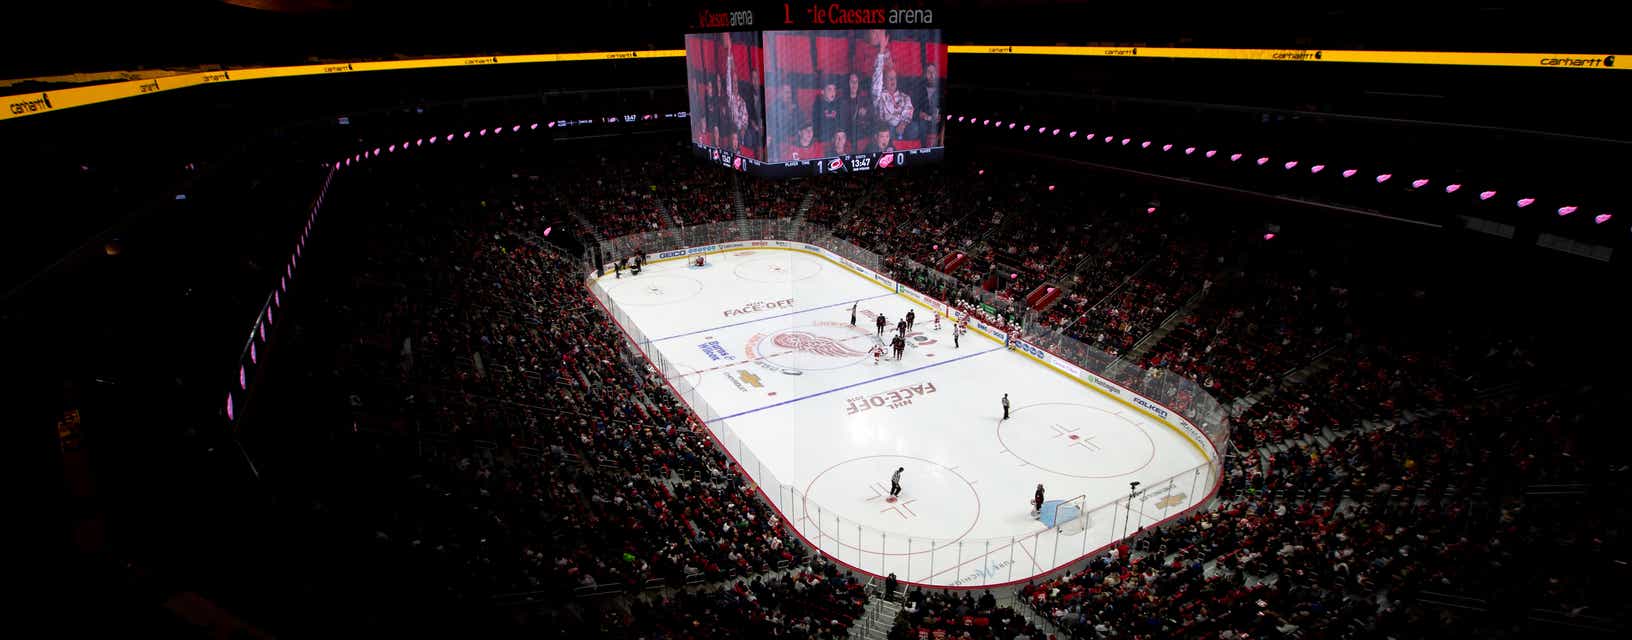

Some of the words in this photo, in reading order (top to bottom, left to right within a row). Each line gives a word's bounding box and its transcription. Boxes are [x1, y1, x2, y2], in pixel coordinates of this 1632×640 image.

[730, 9, 753, 26] arena
[828, 4, 885, 24] Caesars
[888, 8, 933, 24] arena
[1540, 58, 1602, 67] carhartt
[10, 98, 47, 115] carhartt
[818, 160, 823, 173] 1
[851, 158, 871, 169] 13:47
[897, 152, 904, 165] 0
[659, 250, 686, 259] GEICO
[723, 298, 794, 318] FACE-OFF
[846, 382, 937, 415] FACE-OFF
[1132, 397, 1168, 418] FALKEN
